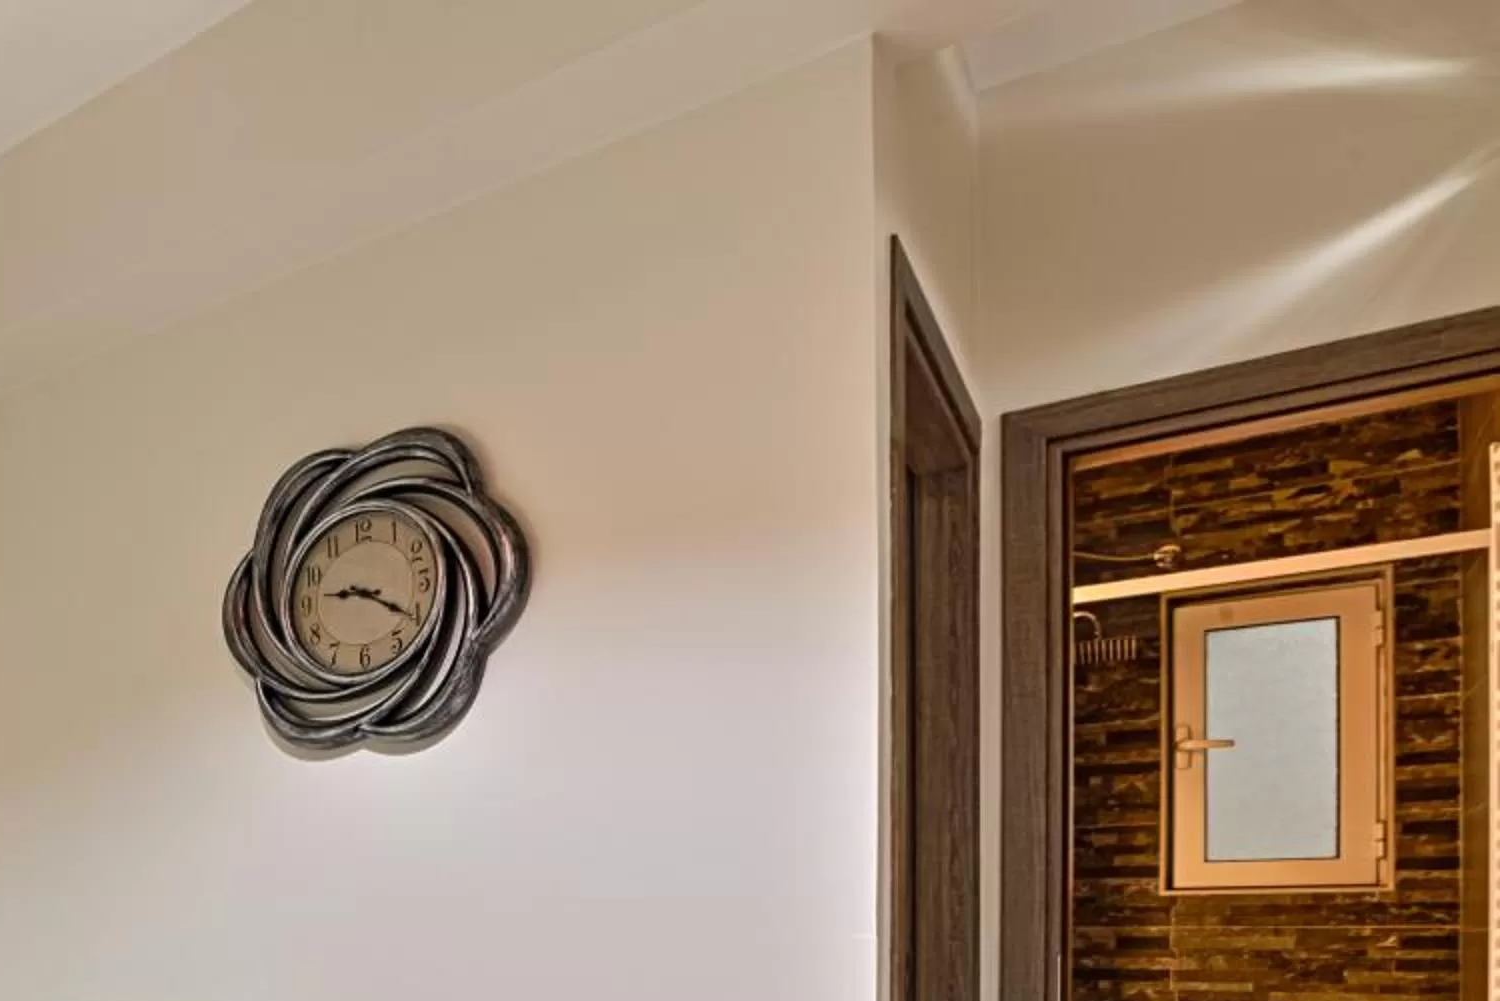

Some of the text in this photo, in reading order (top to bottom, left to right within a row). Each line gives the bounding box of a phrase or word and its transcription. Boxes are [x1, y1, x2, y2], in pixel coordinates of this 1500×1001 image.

[355, 518, 373, 544] 12
[327, 535, 340, 559] 11
[410, 539, 424, 563] 2
[307, 565, 322, 588] 10
[418, 567, 431, 593] 3
[301, 595, 312, 617] 9
[309, 622, 321, 646] 8
[391, 627, 405, 655] 5
[329, 640, 341, 666] 7
[359, 644, 371, 670] 6
